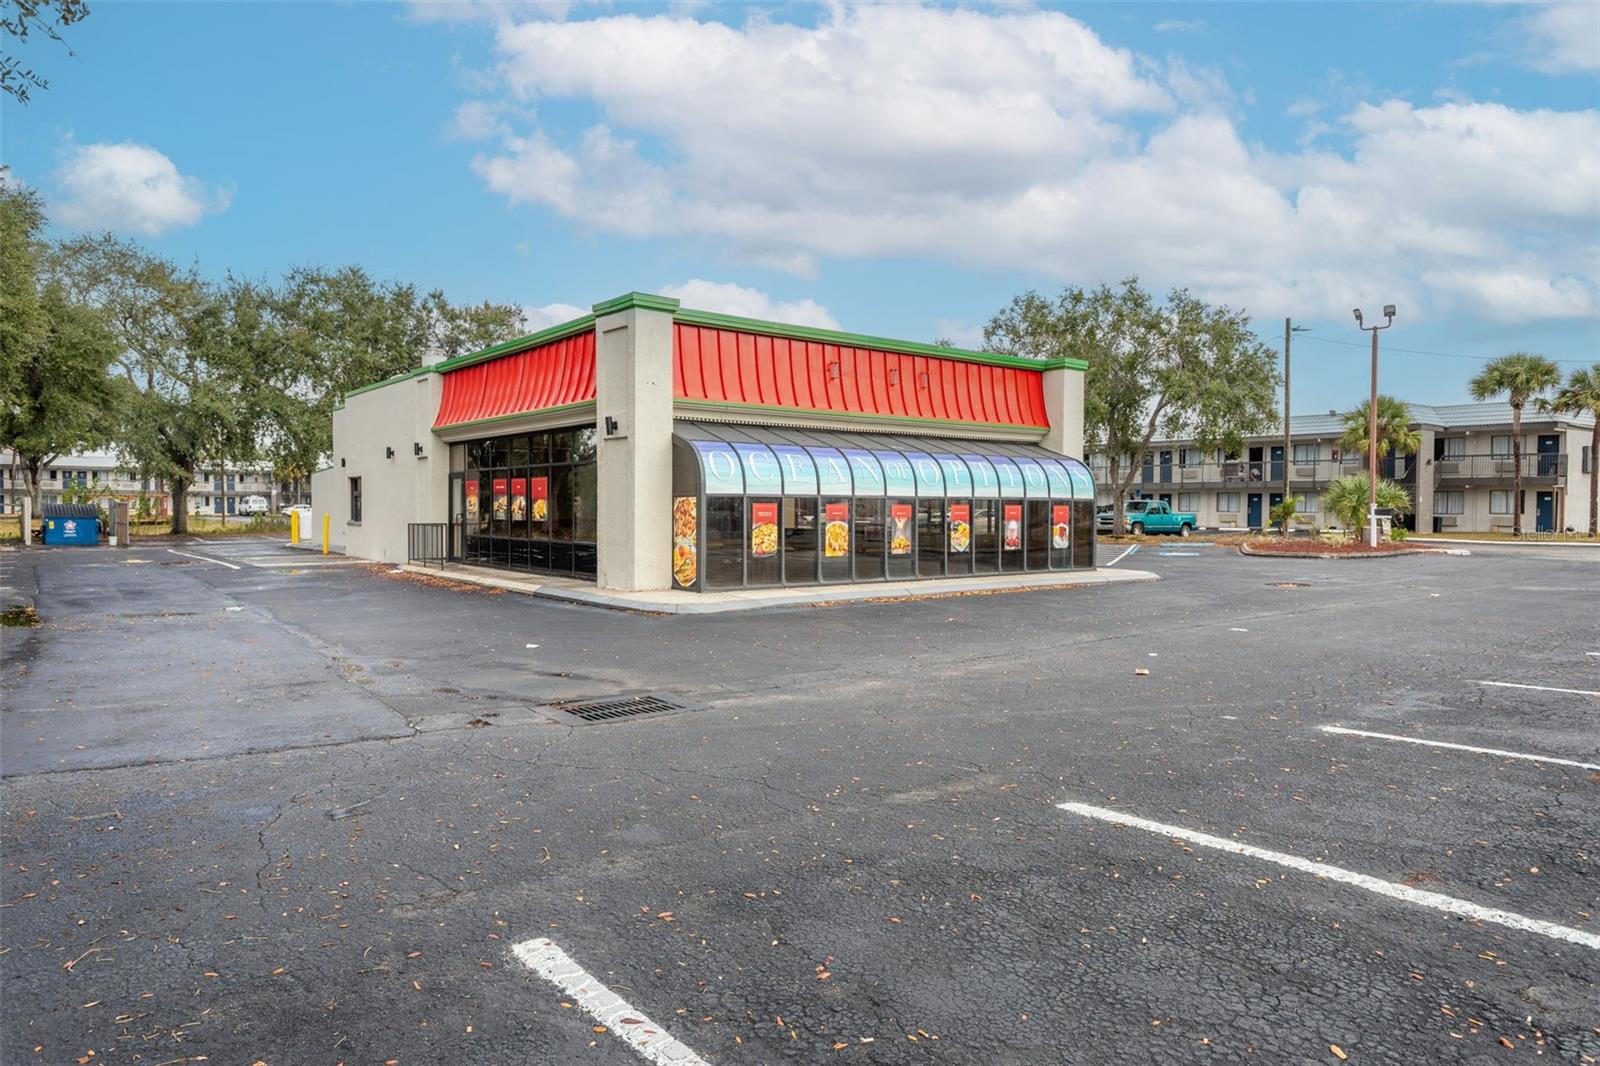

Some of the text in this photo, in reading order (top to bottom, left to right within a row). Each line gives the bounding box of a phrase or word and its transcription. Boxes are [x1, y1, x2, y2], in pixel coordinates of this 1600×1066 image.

[708, 450, 1089, 489] OCEAN OF OPTIONS
